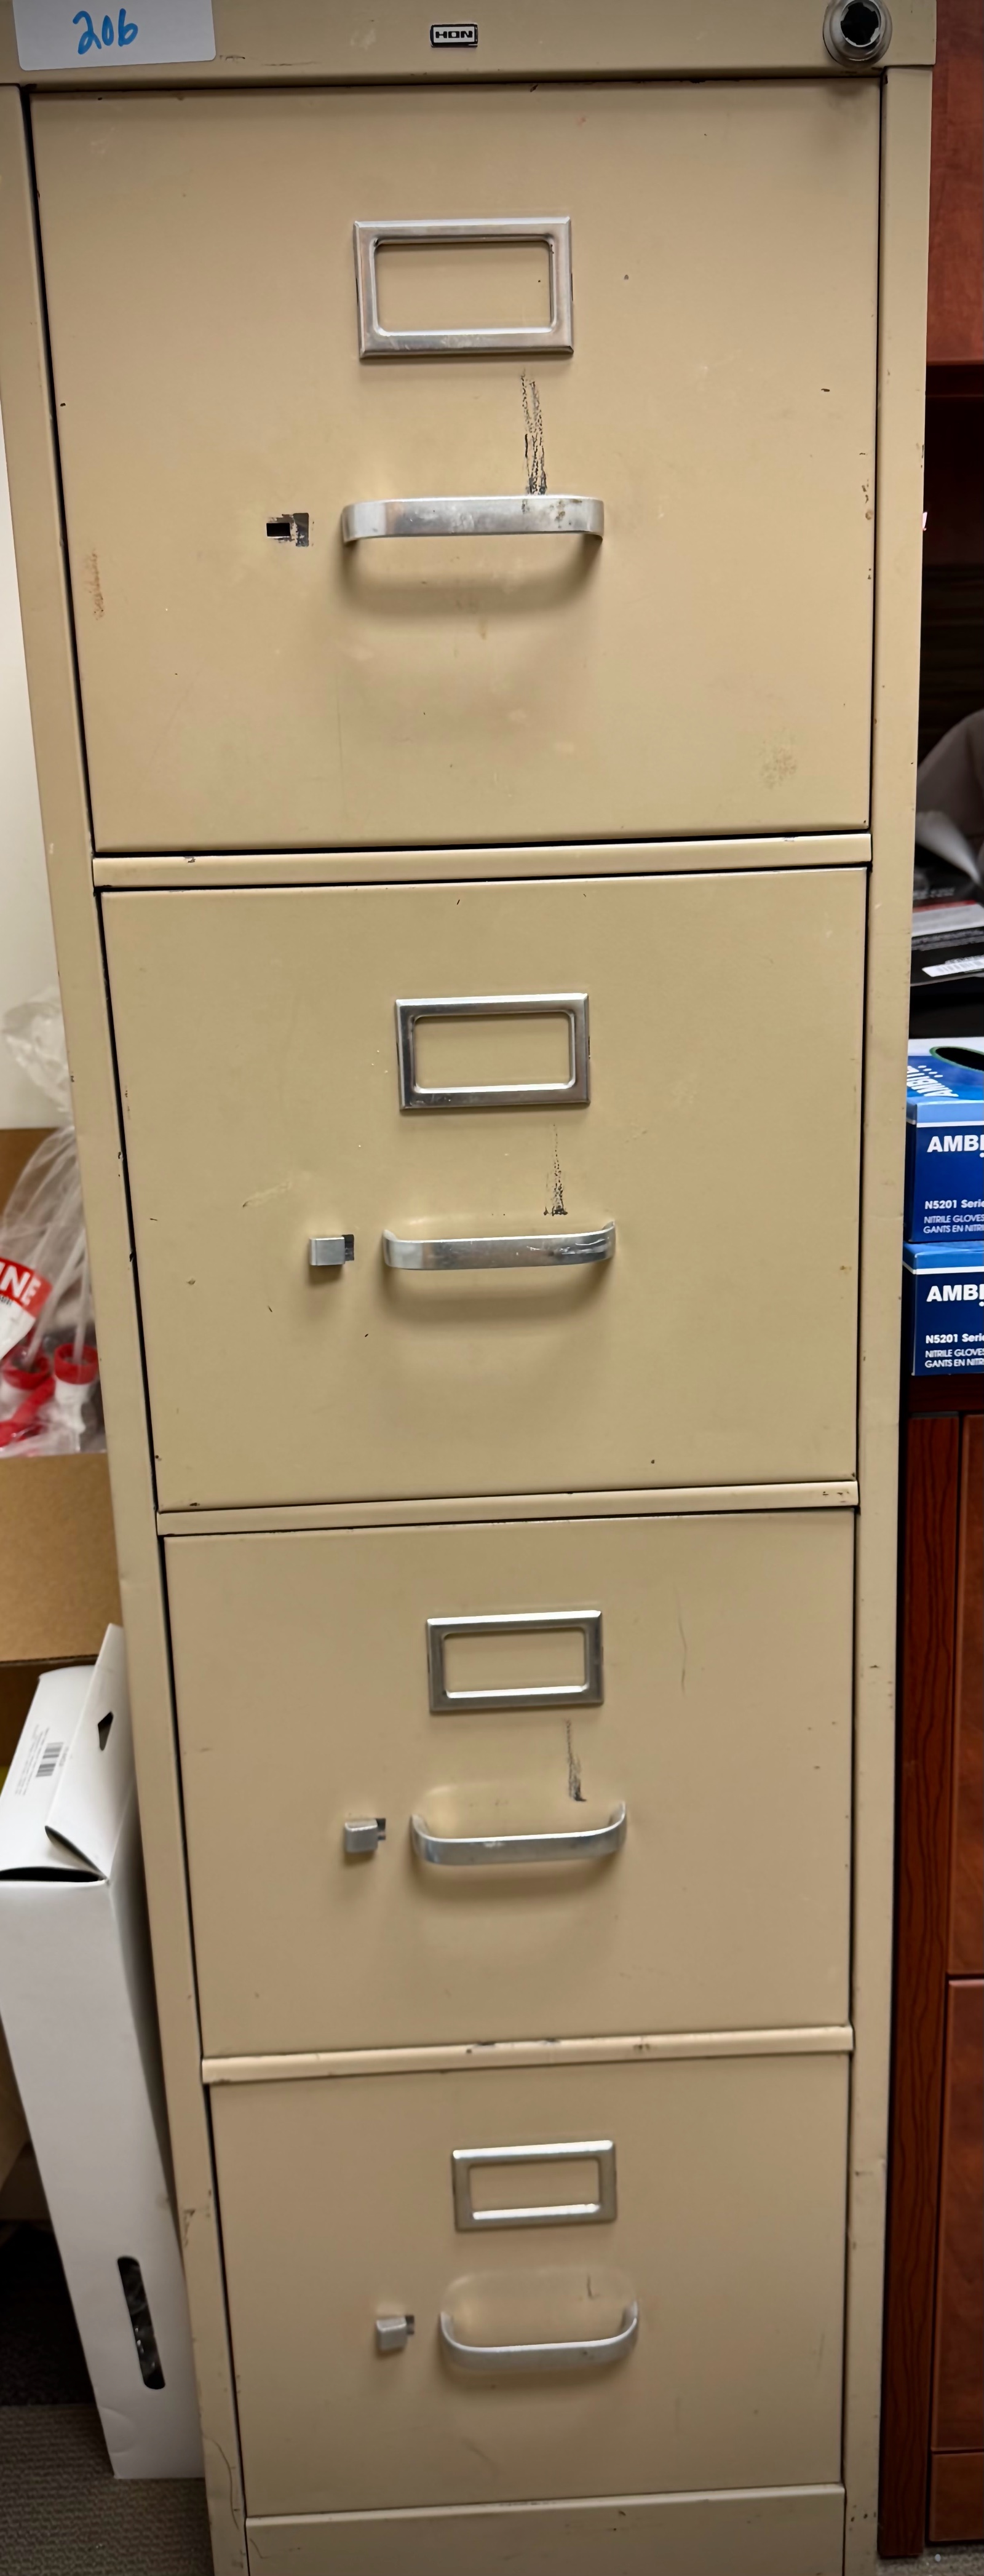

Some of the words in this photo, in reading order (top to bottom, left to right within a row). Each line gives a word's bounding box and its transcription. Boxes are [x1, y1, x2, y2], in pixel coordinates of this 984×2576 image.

[924, 1200, 957, 1210] N5201
[924, 1215, 951, 1224] NITRILE
[923, 1225, 951, 1234] GANTS
[952, 1224, 964, 1233] EN
[0, 1262, 41, 1307] NE
[926, 1334, 958, 1344] N5201
[925, 1349, 953, 1358] NITRILE
[924, 1359, 953, 1368] GANTS
[953, 1358, 966, 1367] EN
